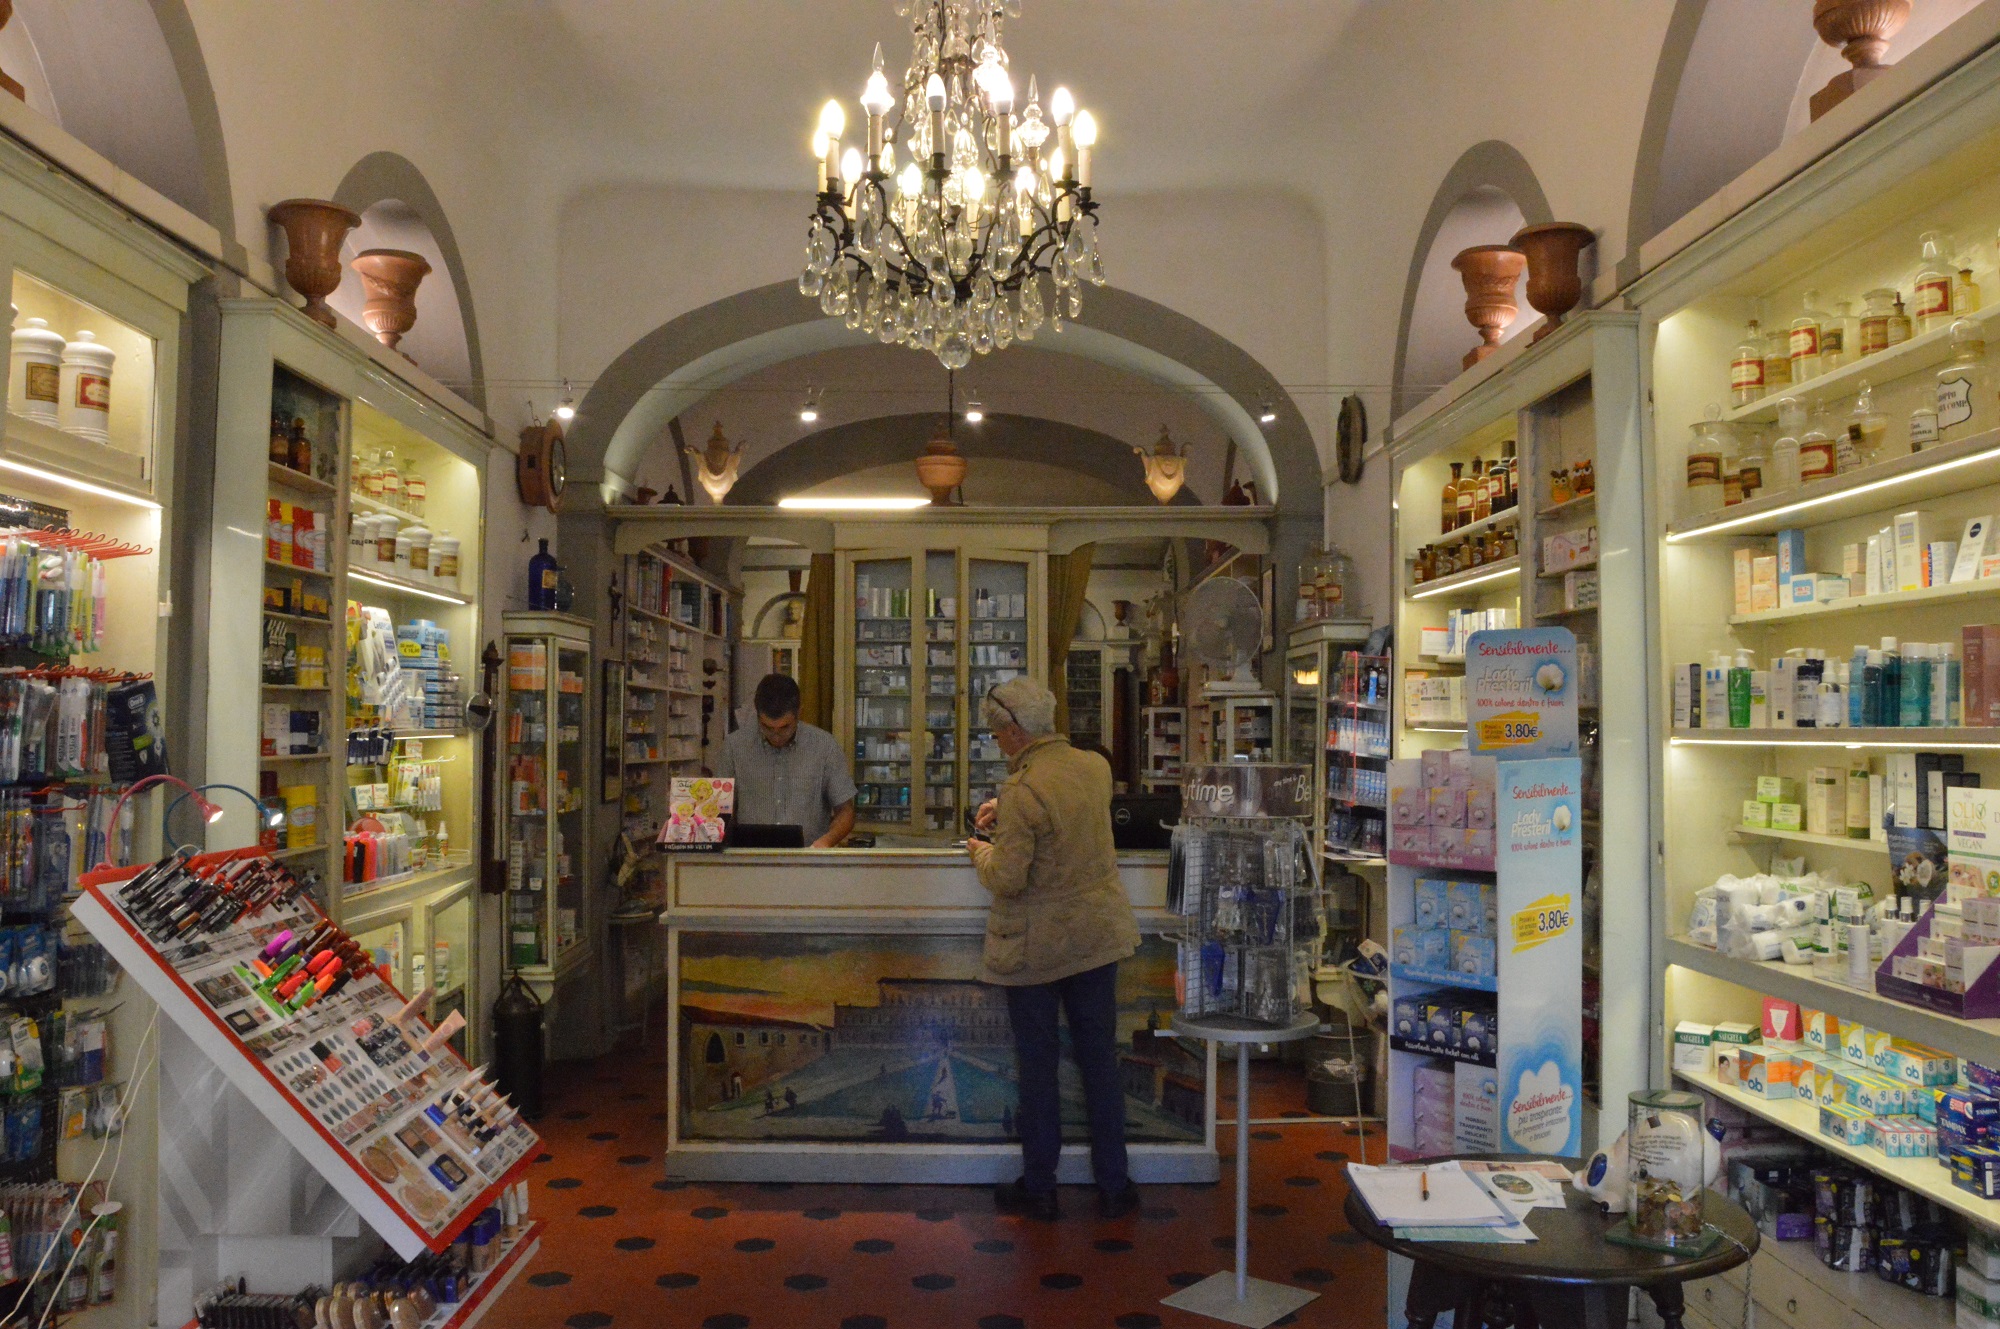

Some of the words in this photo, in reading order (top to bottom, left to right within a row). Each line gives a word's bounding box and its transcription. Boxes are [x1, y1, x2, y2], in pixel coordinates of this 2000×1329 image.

[1485, 665, 1518, 682] Lady
[1476, 677, 1534, 694] Presteril
[1517, 697, 1539, 708] dentro
[1547, 697, 1565, 709] fuori
[1505, 723, 1538, 739] 3,80€
[1517, 809, 1541, 826] Lady
[1511, 819, 1552, 838] Presteril
[1538, 908, 1569, 934] 3,80€
